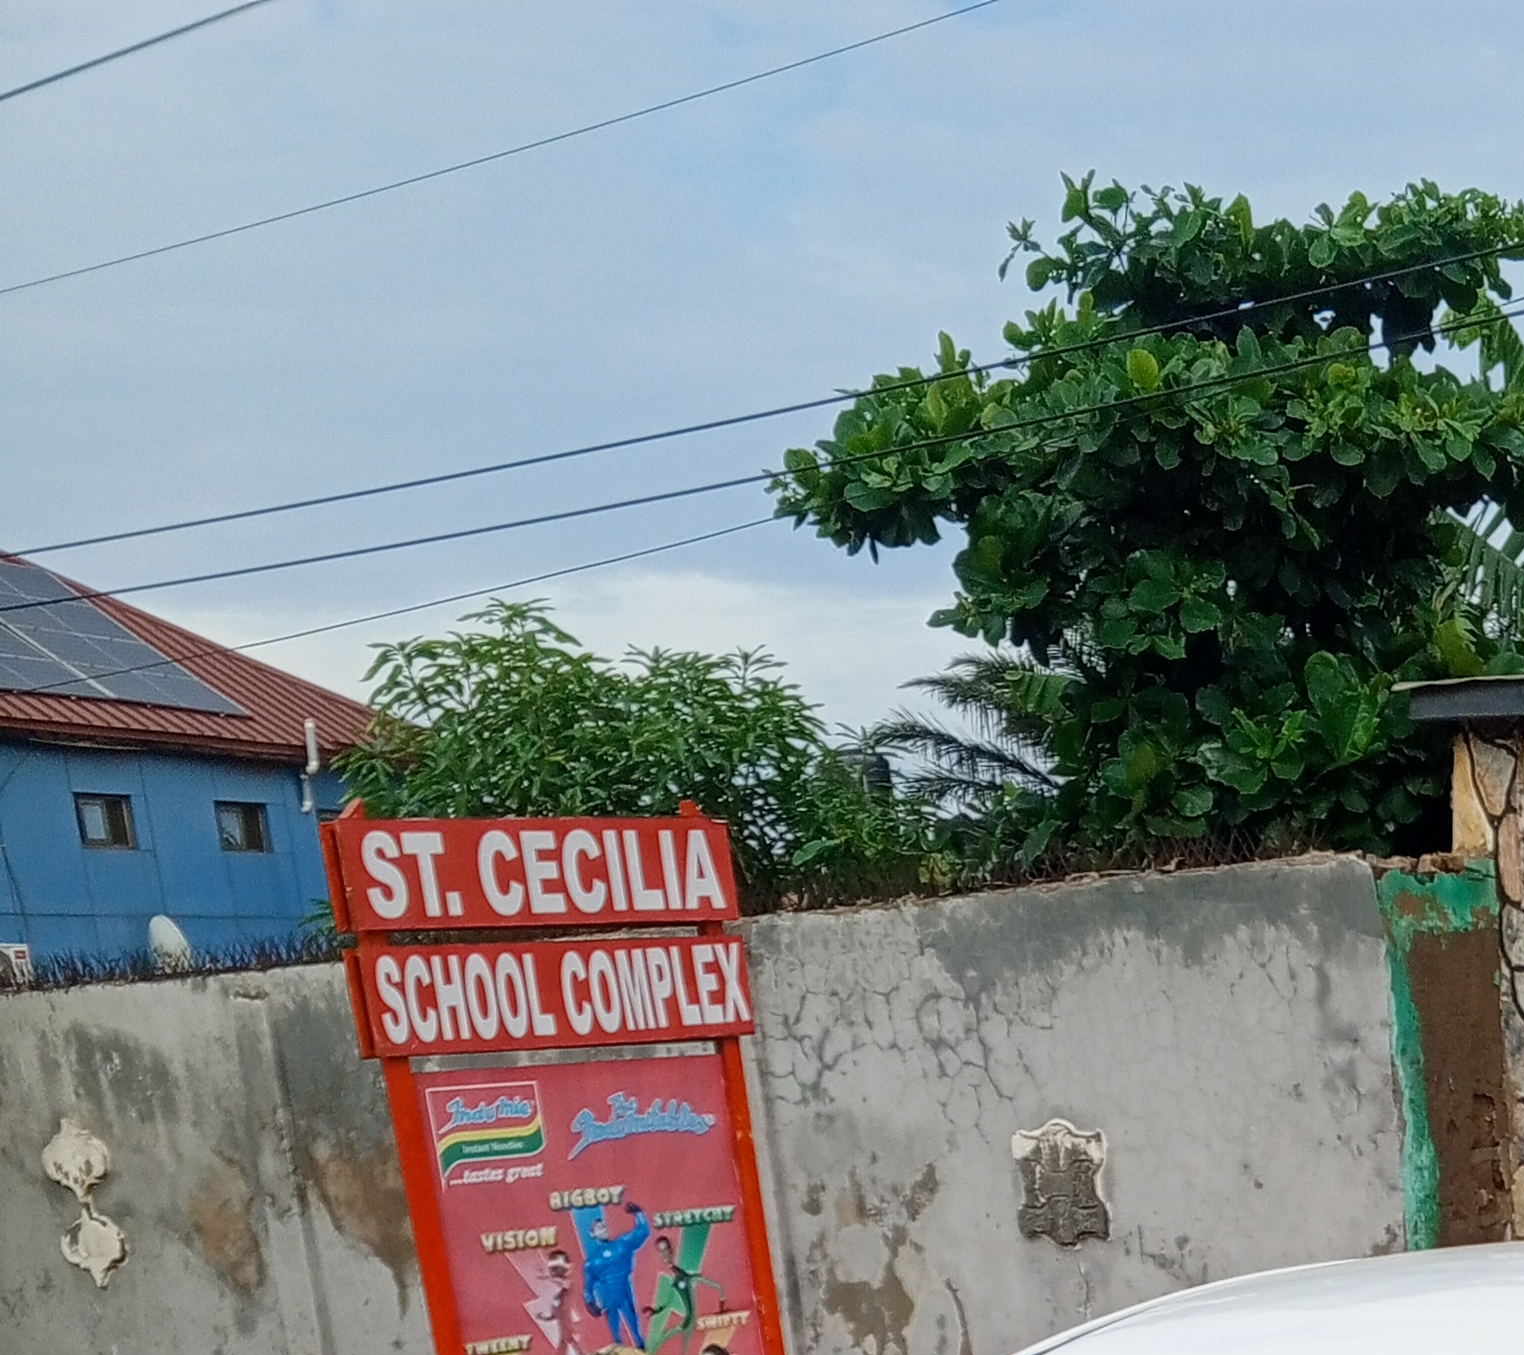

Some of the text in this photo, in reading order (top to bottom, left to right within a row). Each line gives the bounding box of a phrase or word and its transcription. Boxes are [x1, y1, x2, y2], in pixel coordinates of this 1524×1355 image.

[361, 829, 727, 919] ST. CECILIA
[375, 942, 751, 1044] SCHOOL COMPLEX
[505, 1163, 544, 1184] great
[481, 1226, 557, 1252] VISION
